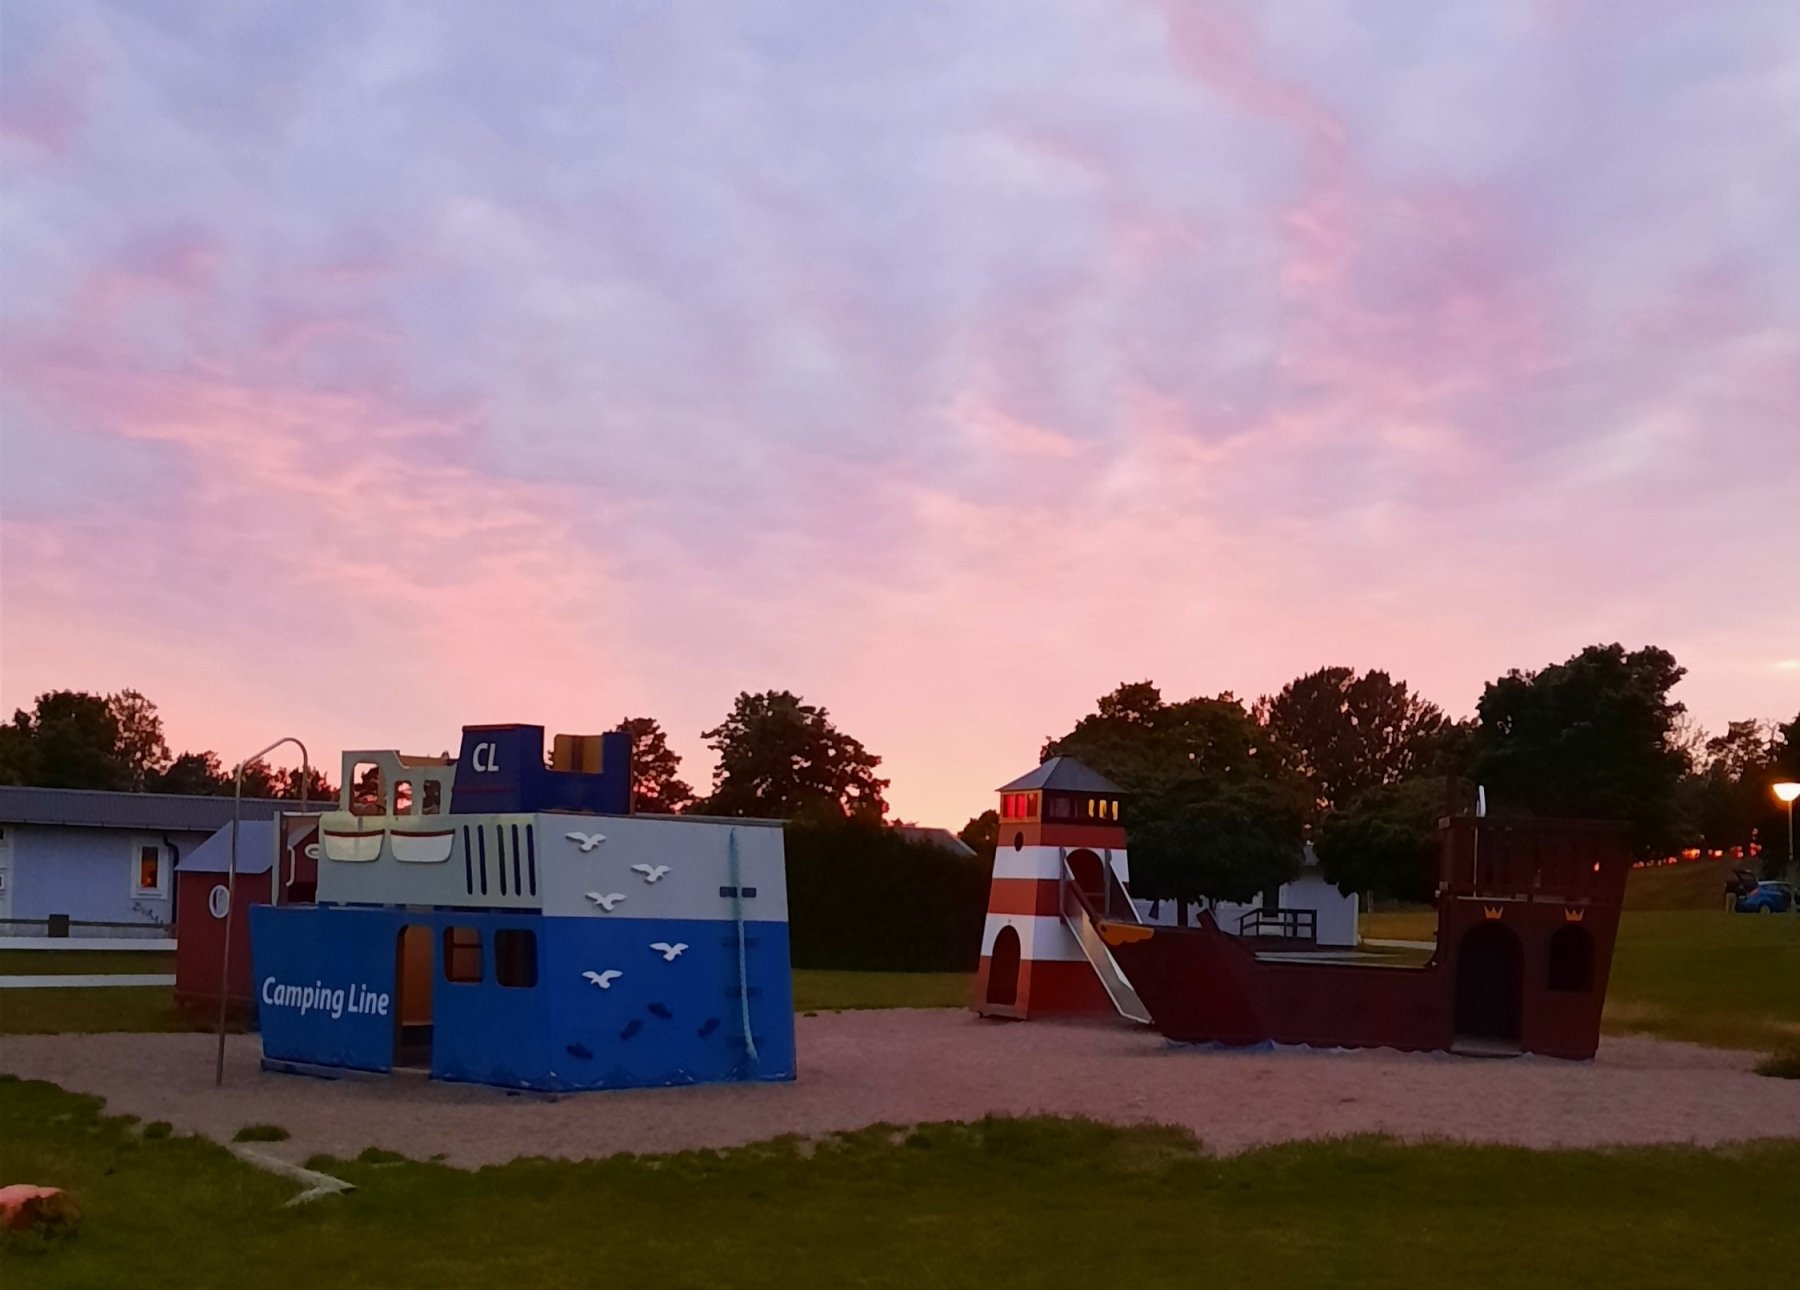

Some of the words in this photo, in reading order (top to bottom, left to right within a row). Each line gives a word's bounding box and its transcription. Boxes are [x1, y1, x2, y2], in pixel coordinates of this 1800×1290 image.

[473, 743, 499, 772] CL
[262, 977, 344, 1019] Camping
[348, 984, 389, 1015] Line
